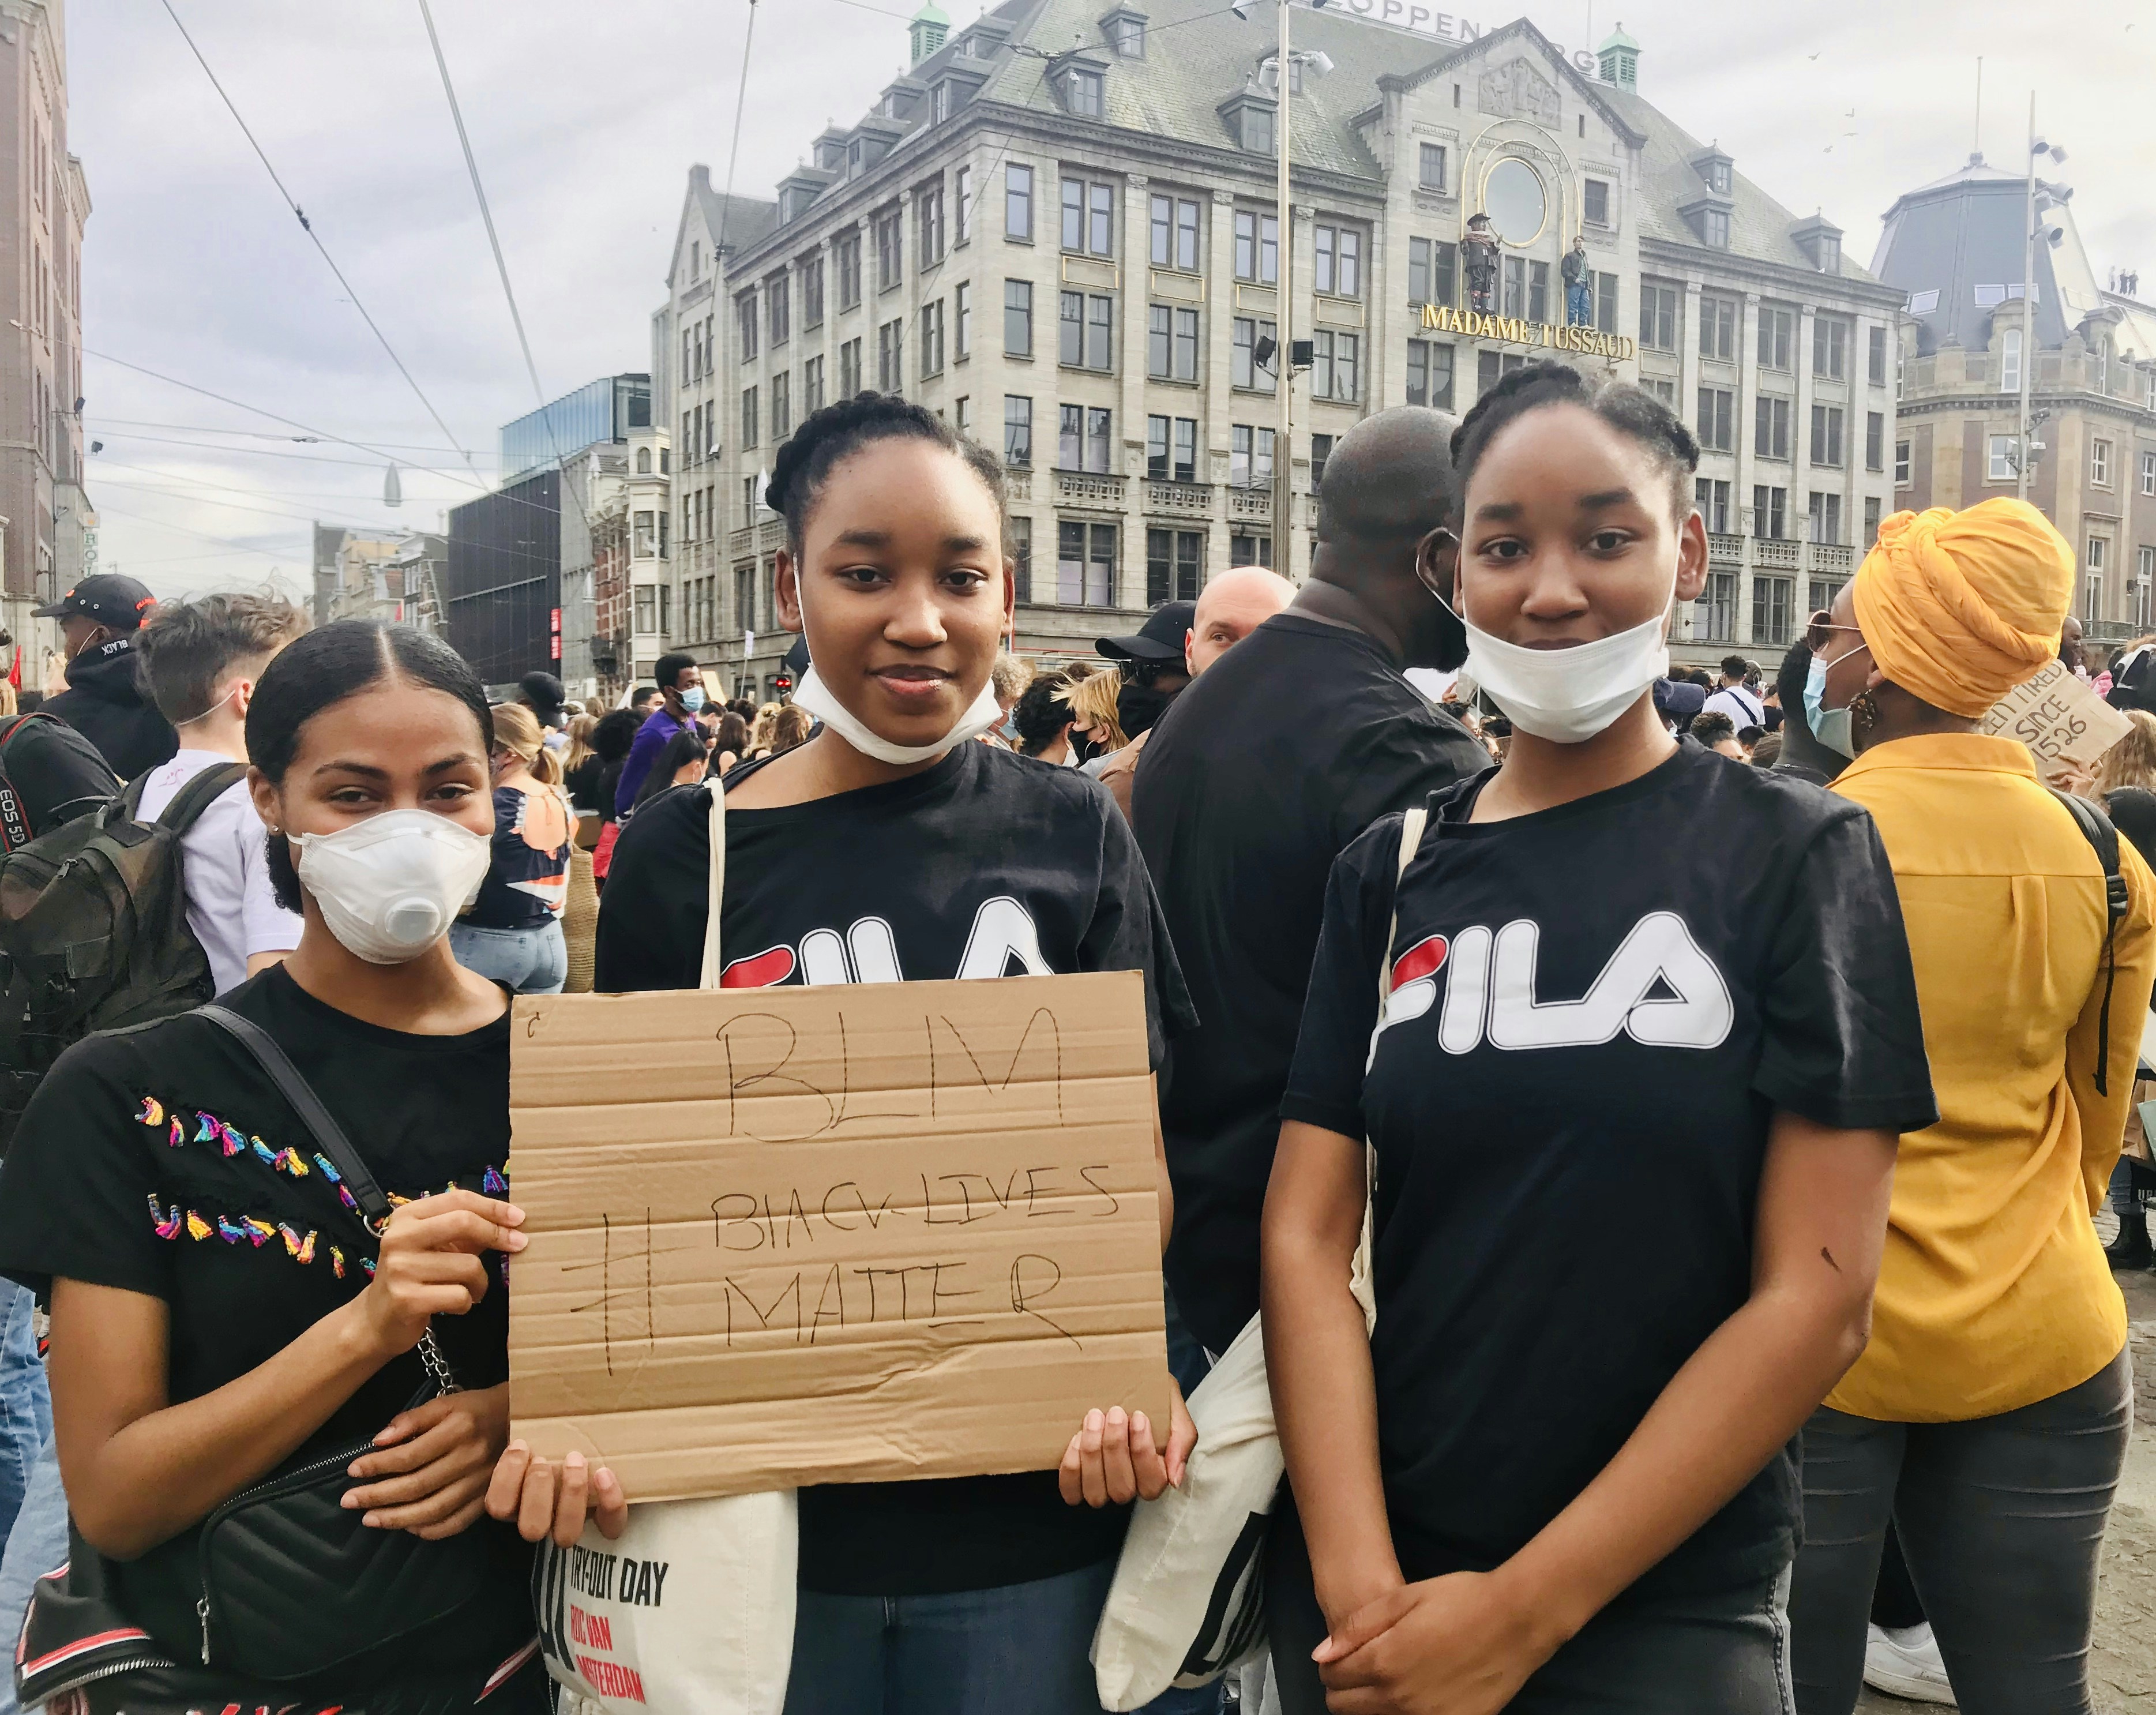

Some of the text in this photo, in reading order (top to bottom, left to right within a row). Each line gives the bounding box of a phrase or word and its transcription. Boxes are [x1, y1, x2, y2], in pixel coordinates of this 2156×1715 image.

[1422, 304, 1634, 360] MADAME TUSSAUD
[102, 639, 128, 656] BLACK
[2011, 663, 2063, 704] TIRED
[2015, 693, 2071, 744] SINCE
[2031, 714, 2087, 762] 1526
[0, 789, 25, 843] EOS 5D
[1384, 910, 1734, 1055] FILA
[717, 1007, 1064, 1143] BLM
[922, 1164, 1120, 1228] LIVES
[725, 1253, 1083, 1350] MATTER
[571, 1544, 668, 1607] TRY-OUT DAY
[586, 1612, 613, 1651] VAN
